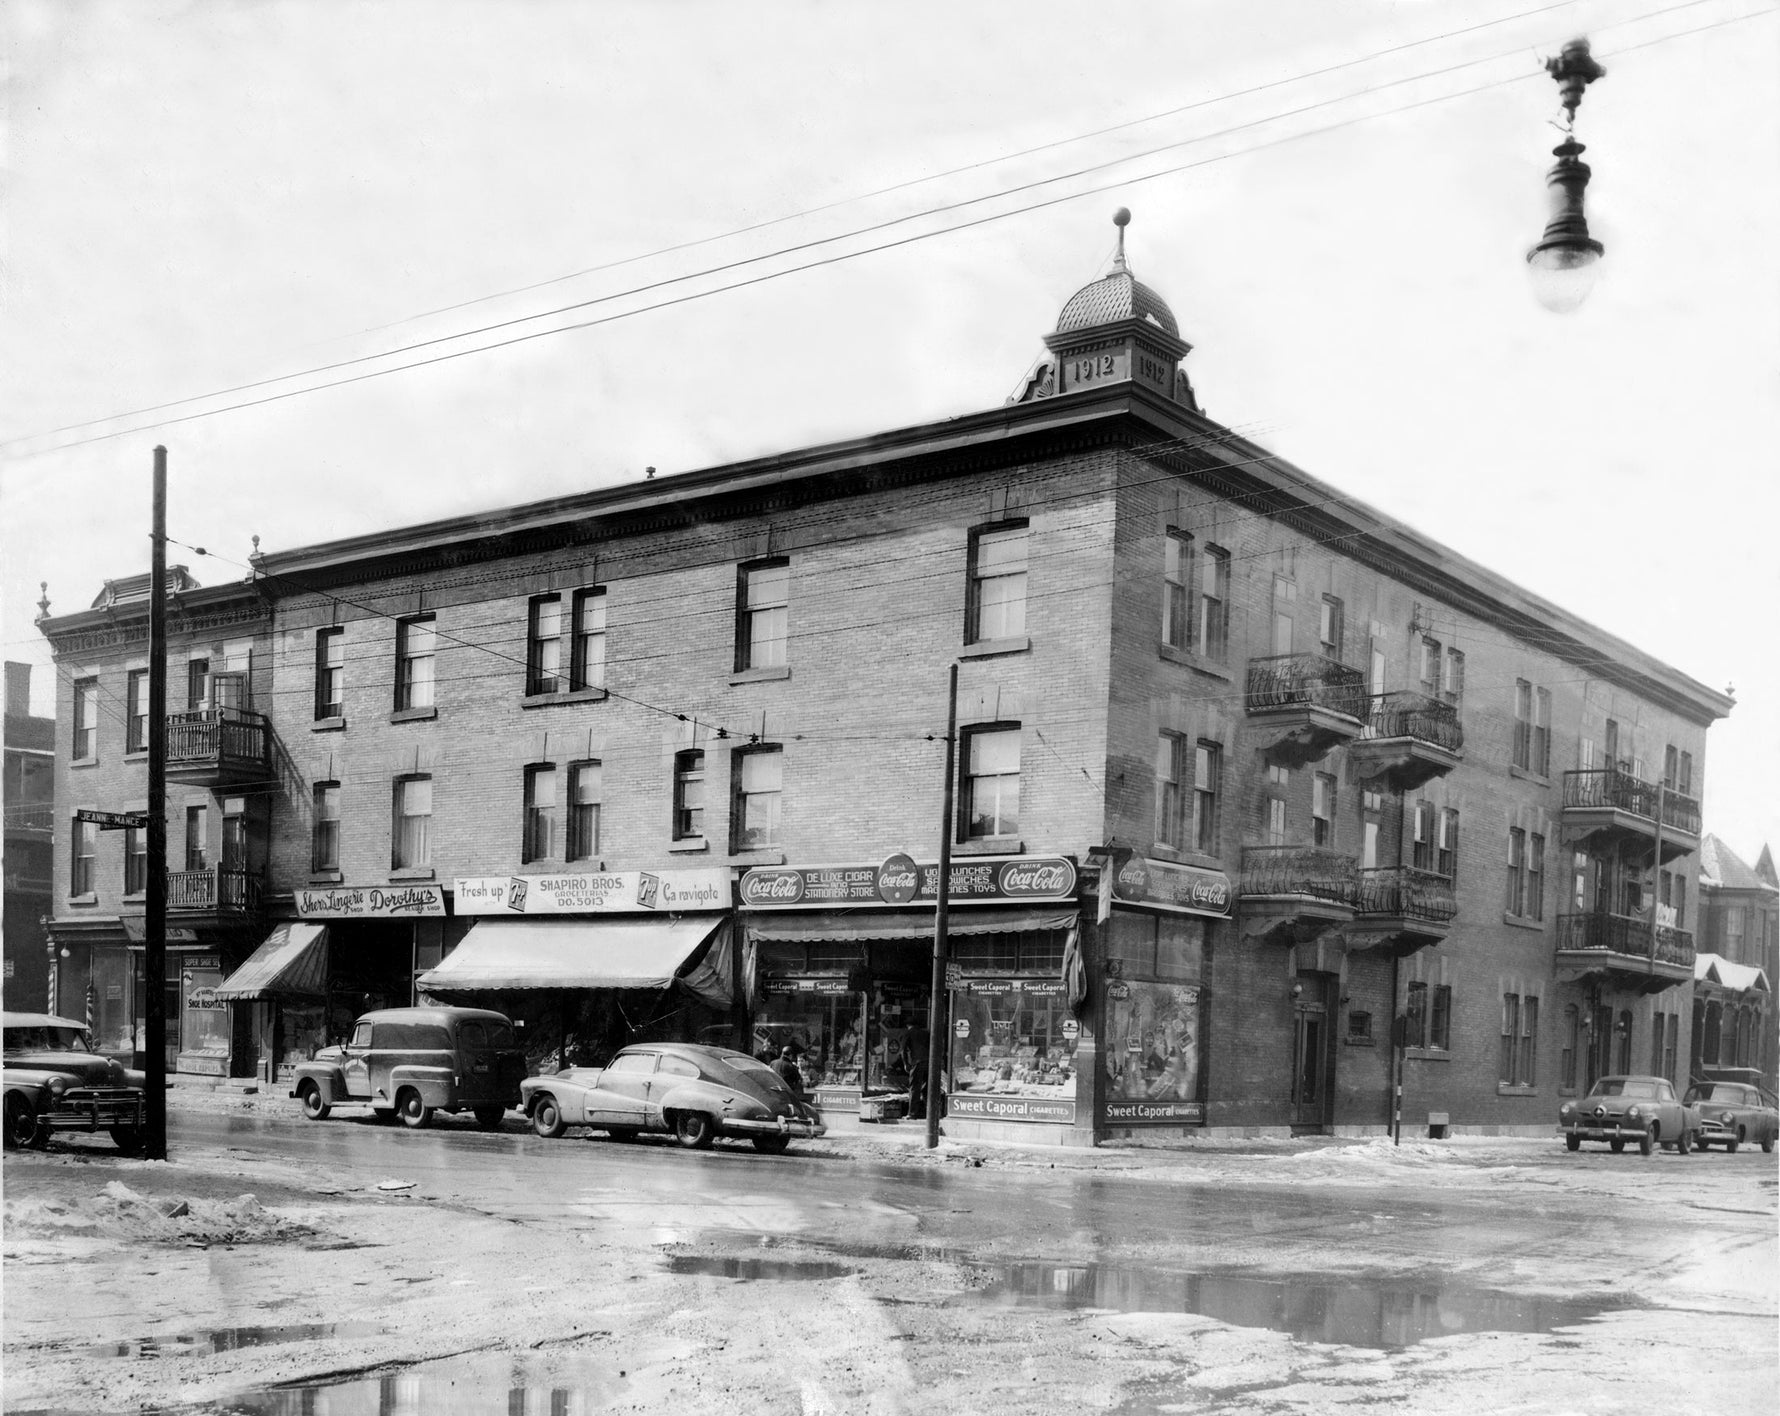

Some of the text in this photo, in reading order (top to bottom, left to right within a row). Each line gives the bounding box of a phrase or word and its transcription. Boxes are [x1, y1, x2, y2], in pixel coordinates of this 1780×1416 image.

[1075, 355, 1115, 383] 1912
[1140, 356, 1165, 384] 1912
[807, 871, 873, 882] DE LUXE CIGAR
[952, 866, 992, 875] LUNCHES
[1004, 866, 1066, 890] Coca-Cola
[540, 877, 625, 891] SHAPIRO BROS.
[747, 875, 799, 898] Coca-Cola
[879, 872, 917, 888] Coca-Cola
[680, 884, 718, 905] ravigote
[805, 887, 874, 898] STATIONERY STORE
[973, 885, 996, 893] TOYS
[1193, 880, 1226, 905] Coca-Cola
[326, 891, 364, 914] Lingerie
[370, 889, 438, 914] Dorothy's
[816, 982, 831, 990] Sweet
[970, 982, 987, 991] Sweet
[988, 982, 1011, 991] Caporal
[1023, 983, 1066, 991] Sweet Caporal
[188, 999, 200, 1009] SHOE
[823, 1096, 857, 1105] CIGARETTES
[953, 1099, 1069, 1116] Sweet Caporal CIGARETTES
[1106, 1104, 1137, 1117] Sweet
[1138, 1105, 1174, 1119] Caporal
